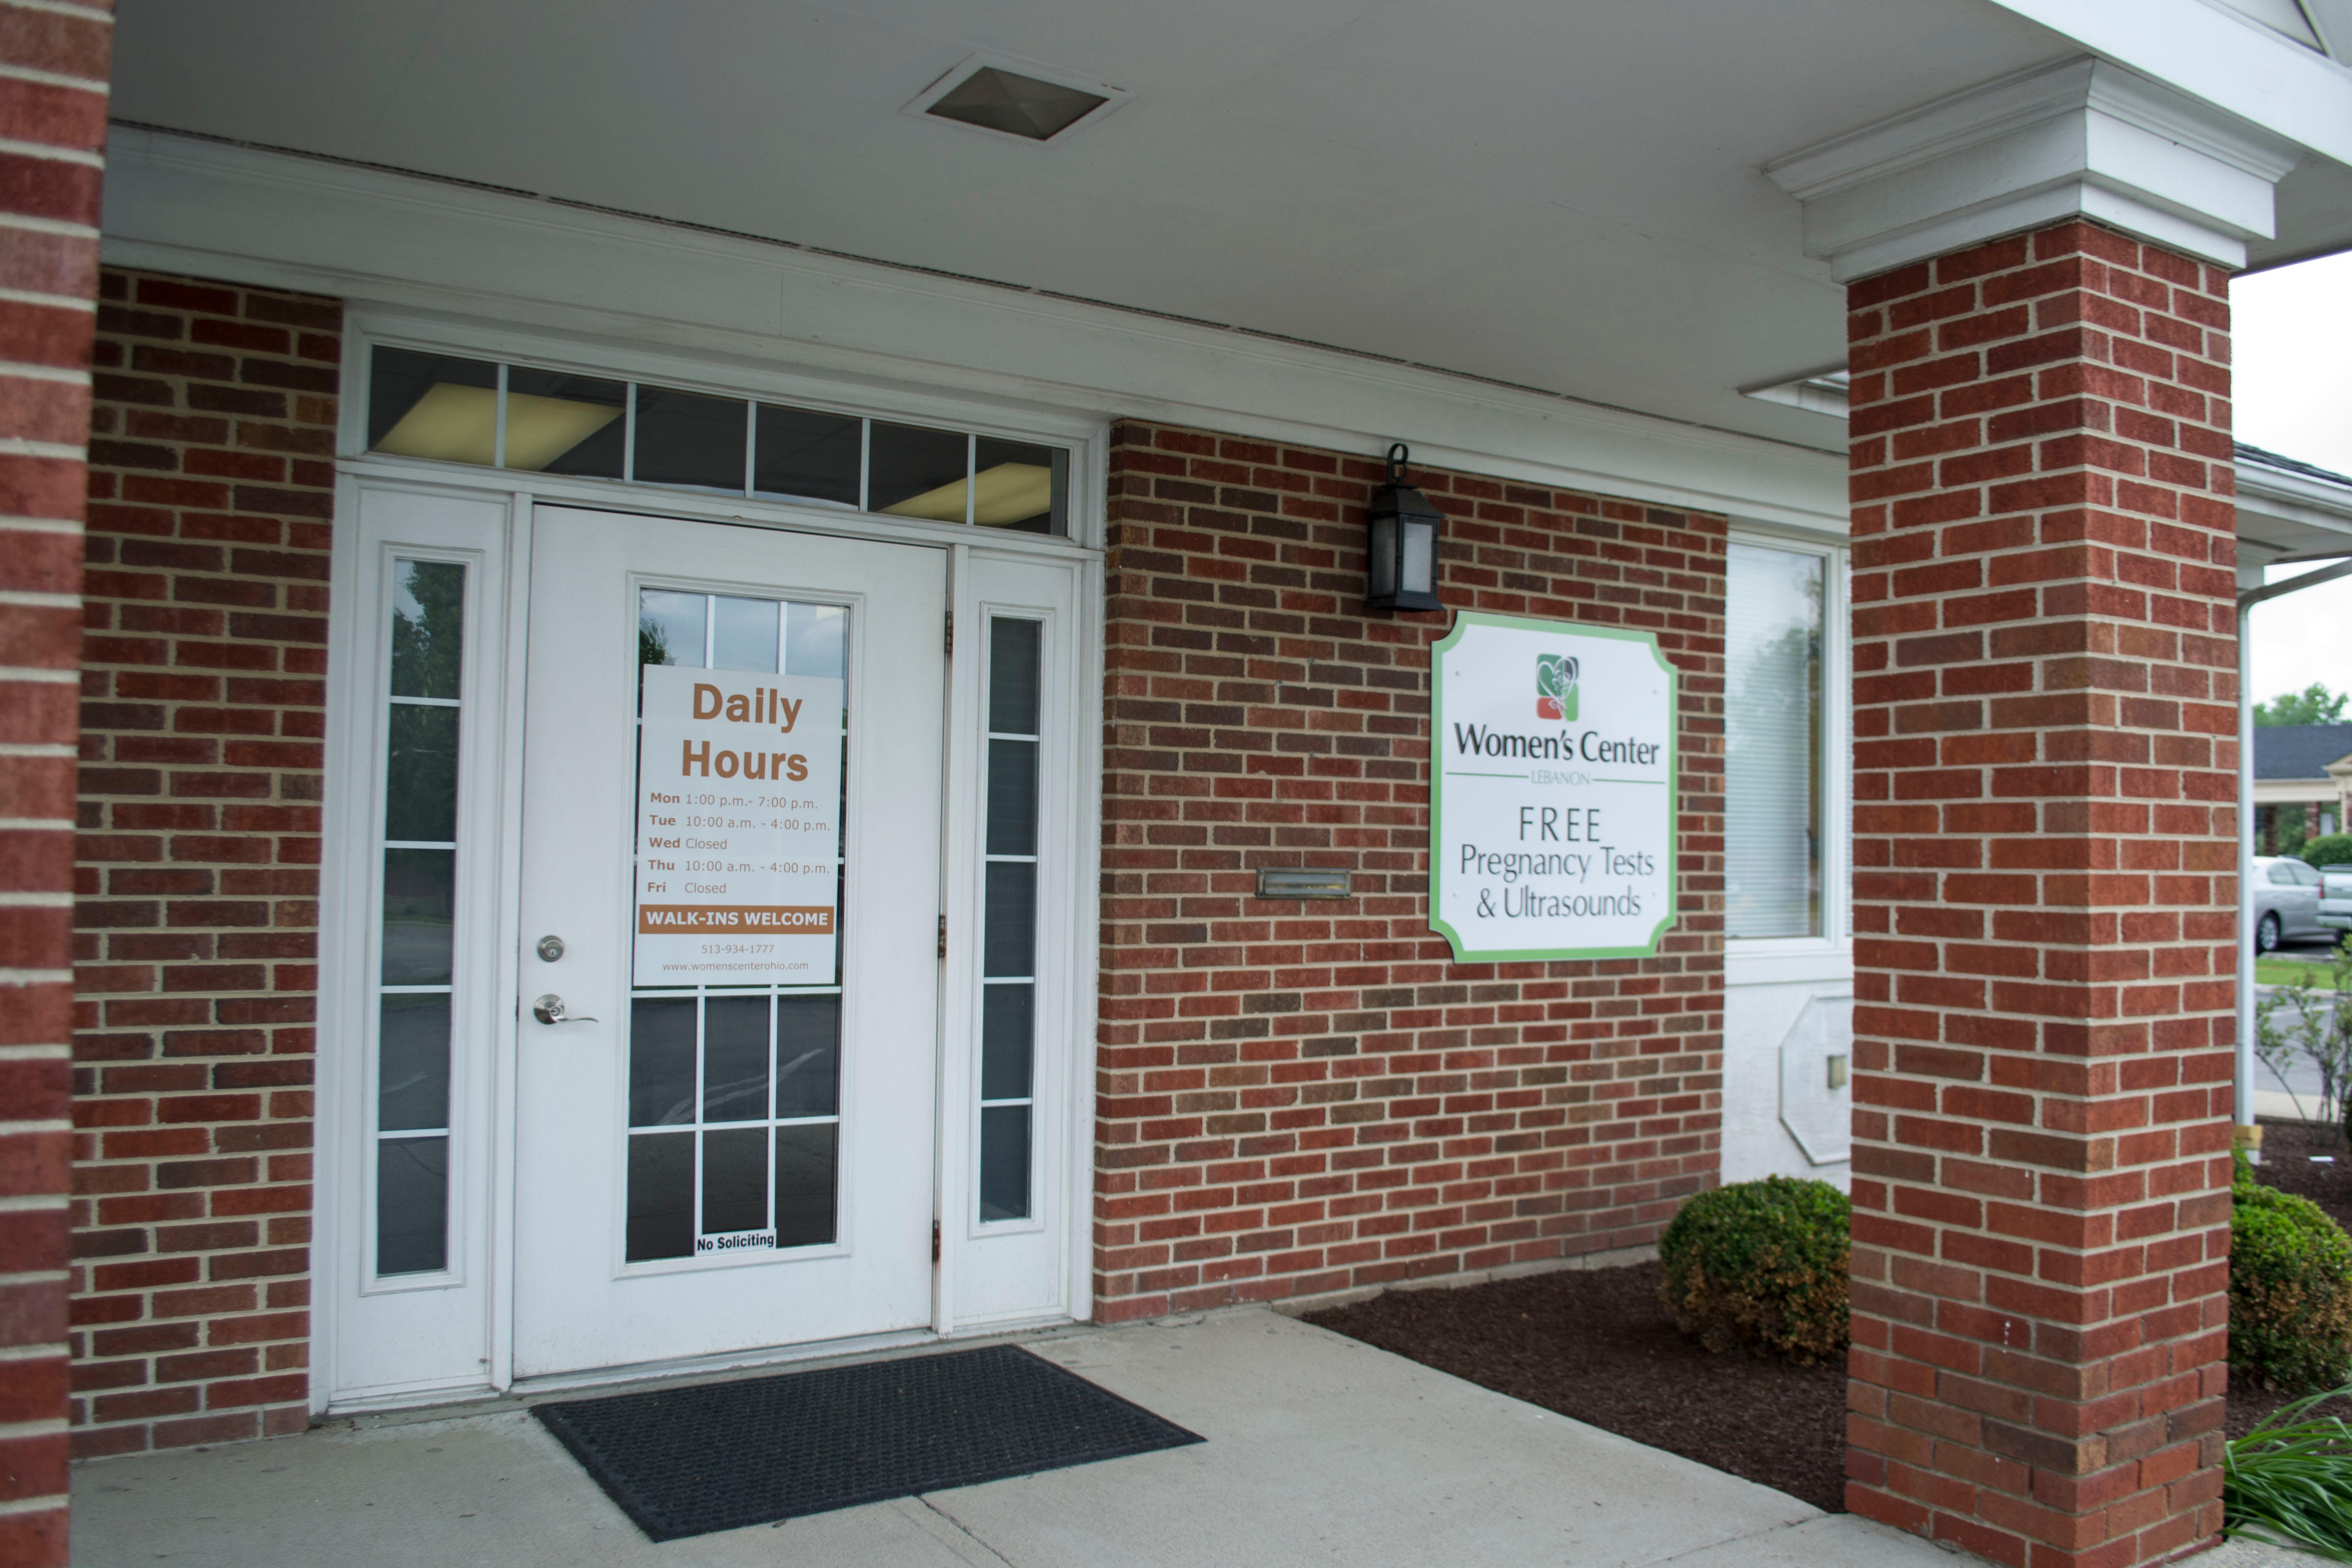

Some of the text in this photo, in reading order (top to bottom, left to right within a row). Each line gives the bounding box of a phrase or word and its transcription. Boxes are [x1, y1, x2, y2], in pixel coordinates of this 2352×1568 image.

[693, 683, 802, 733] Daily
[1454, 723, 1660, 764] Women's Center
[682, 740, 808, 781] Hours
[1531, 770, 1591, 785] LEBANON
[650, 793, 680, 803] Mon
[686, 794, 715, 805] 1:00
[758, 797, 787, 808] 7:00
[791, 799, 818, 811] p.m.
[650, 815, 676, 826] Tue
[687, 816, 723, 827] 10:00
[728, 819, 755, 828] a.m.
[771, 819, 799, 830] 4:00
[804, 821, 830, 833] p.m.
[1520, 806, 1601, 842] FREE
[649, 837, 727, 850] Wed Closed
[648, 860, 675, 870] Thu
[685, 861, 722, 871] 10:00
[727, 863, 755, 872] a.m.
[770, 862, 799, 873] 4:00
[803, 864, 830, 875] p.m.
[1461, 844, 1654, 883] Pregnancy Tests
[648, 882, 726, 894] Fri Closed
[1477, 885, 1640, 918] & Ultrasounds
[647, 912, 828, 926] WALK-INS WELCOME
[702, 944, 774, 953] 513-934-1777
[663, 961, 808, 971] www.womenscenterohio.com
[698, 1234, 774, 1251] No Soliciting
